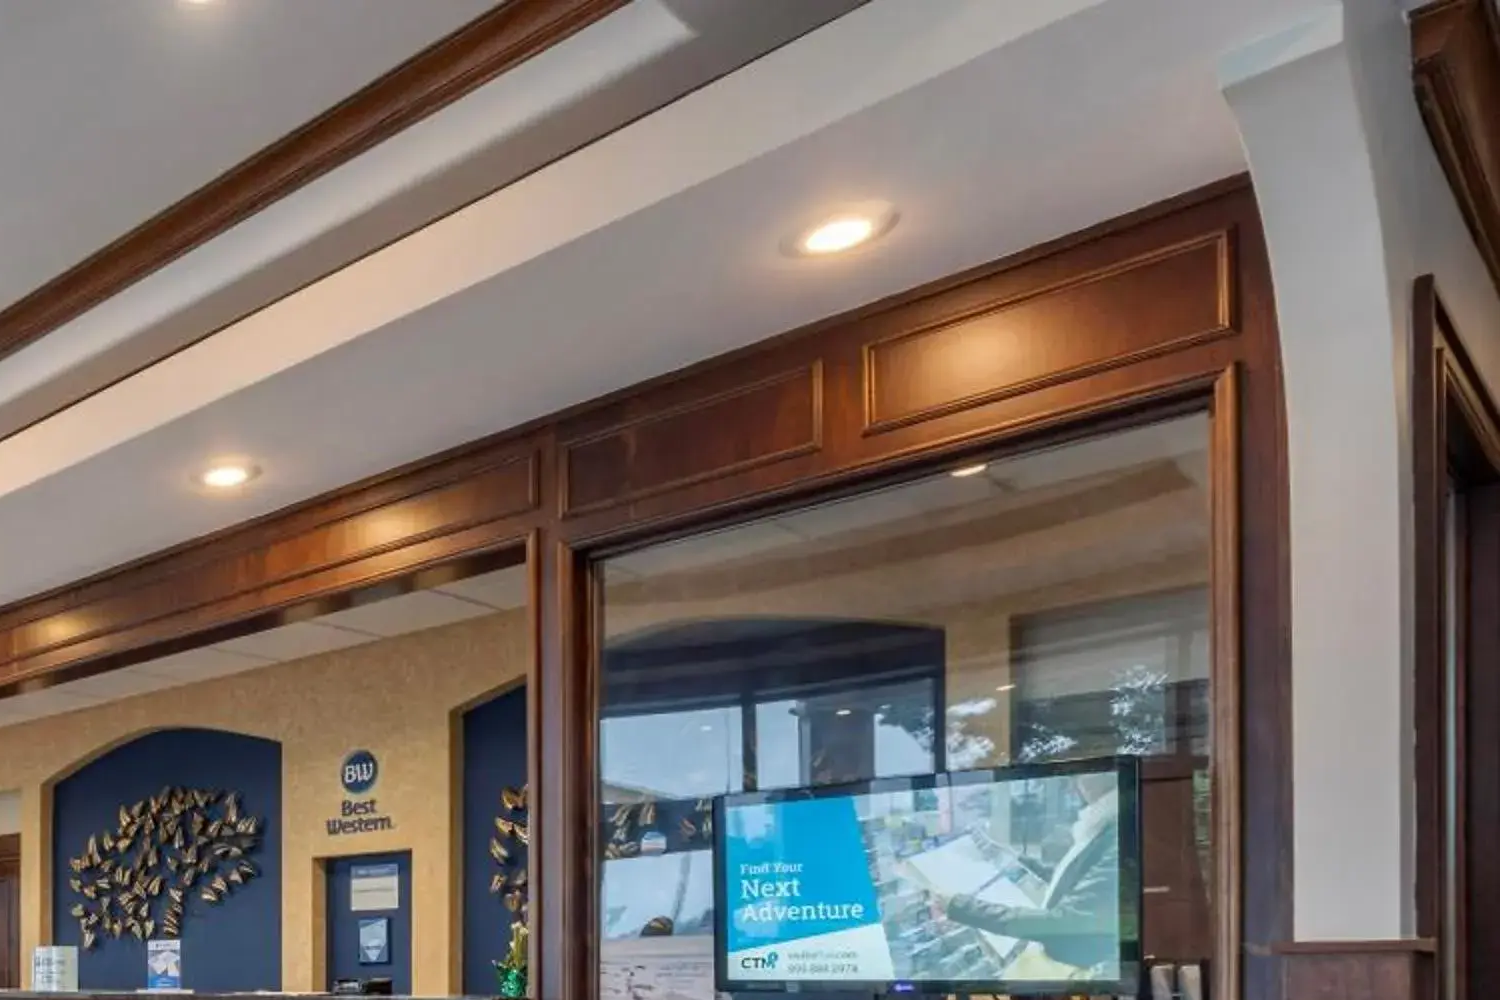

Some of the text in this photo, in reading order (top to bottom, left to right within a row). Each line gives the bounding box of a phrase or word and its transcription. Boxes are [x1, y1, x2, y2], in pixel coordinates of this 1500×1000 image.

[344, 762, 373, 783] BW
[341, 799, 377, 816] Best
[740, 863, 803, 875] Find Your
[740, 878, 801, 899] Next
[742, 902, 864, 922] Adventure
